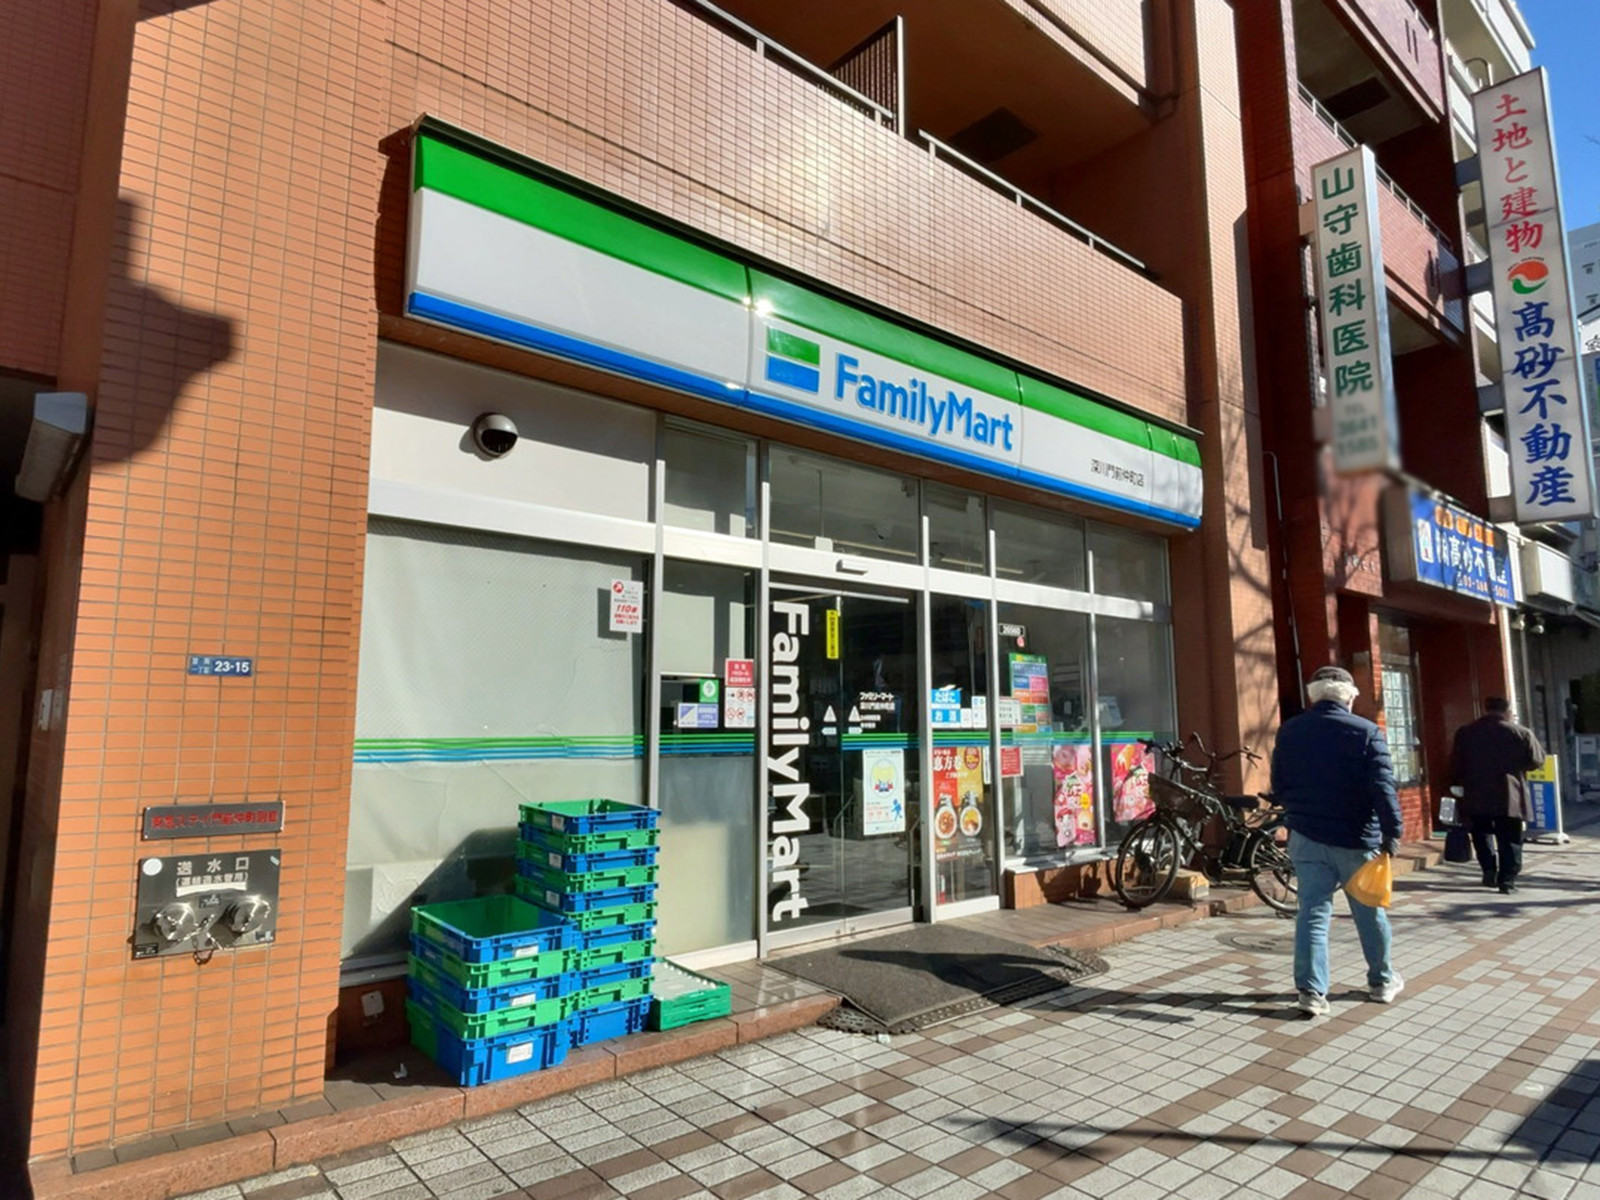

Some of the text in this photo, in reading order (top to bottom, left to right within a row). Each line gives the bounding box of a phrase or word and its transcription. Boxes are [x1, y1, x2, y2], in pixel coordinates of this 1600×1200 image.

[1492, 93, 1543, 254] 土地と建物
[1321, 167, 1374, 398] 山守歯科医院
[834, 351, 1014, 451] FamilyMart
[214, 660, 250, 673] 23-15
[767, 603, 810, 922] FamilyMart
[176, 857, 250, 875] 送水口
